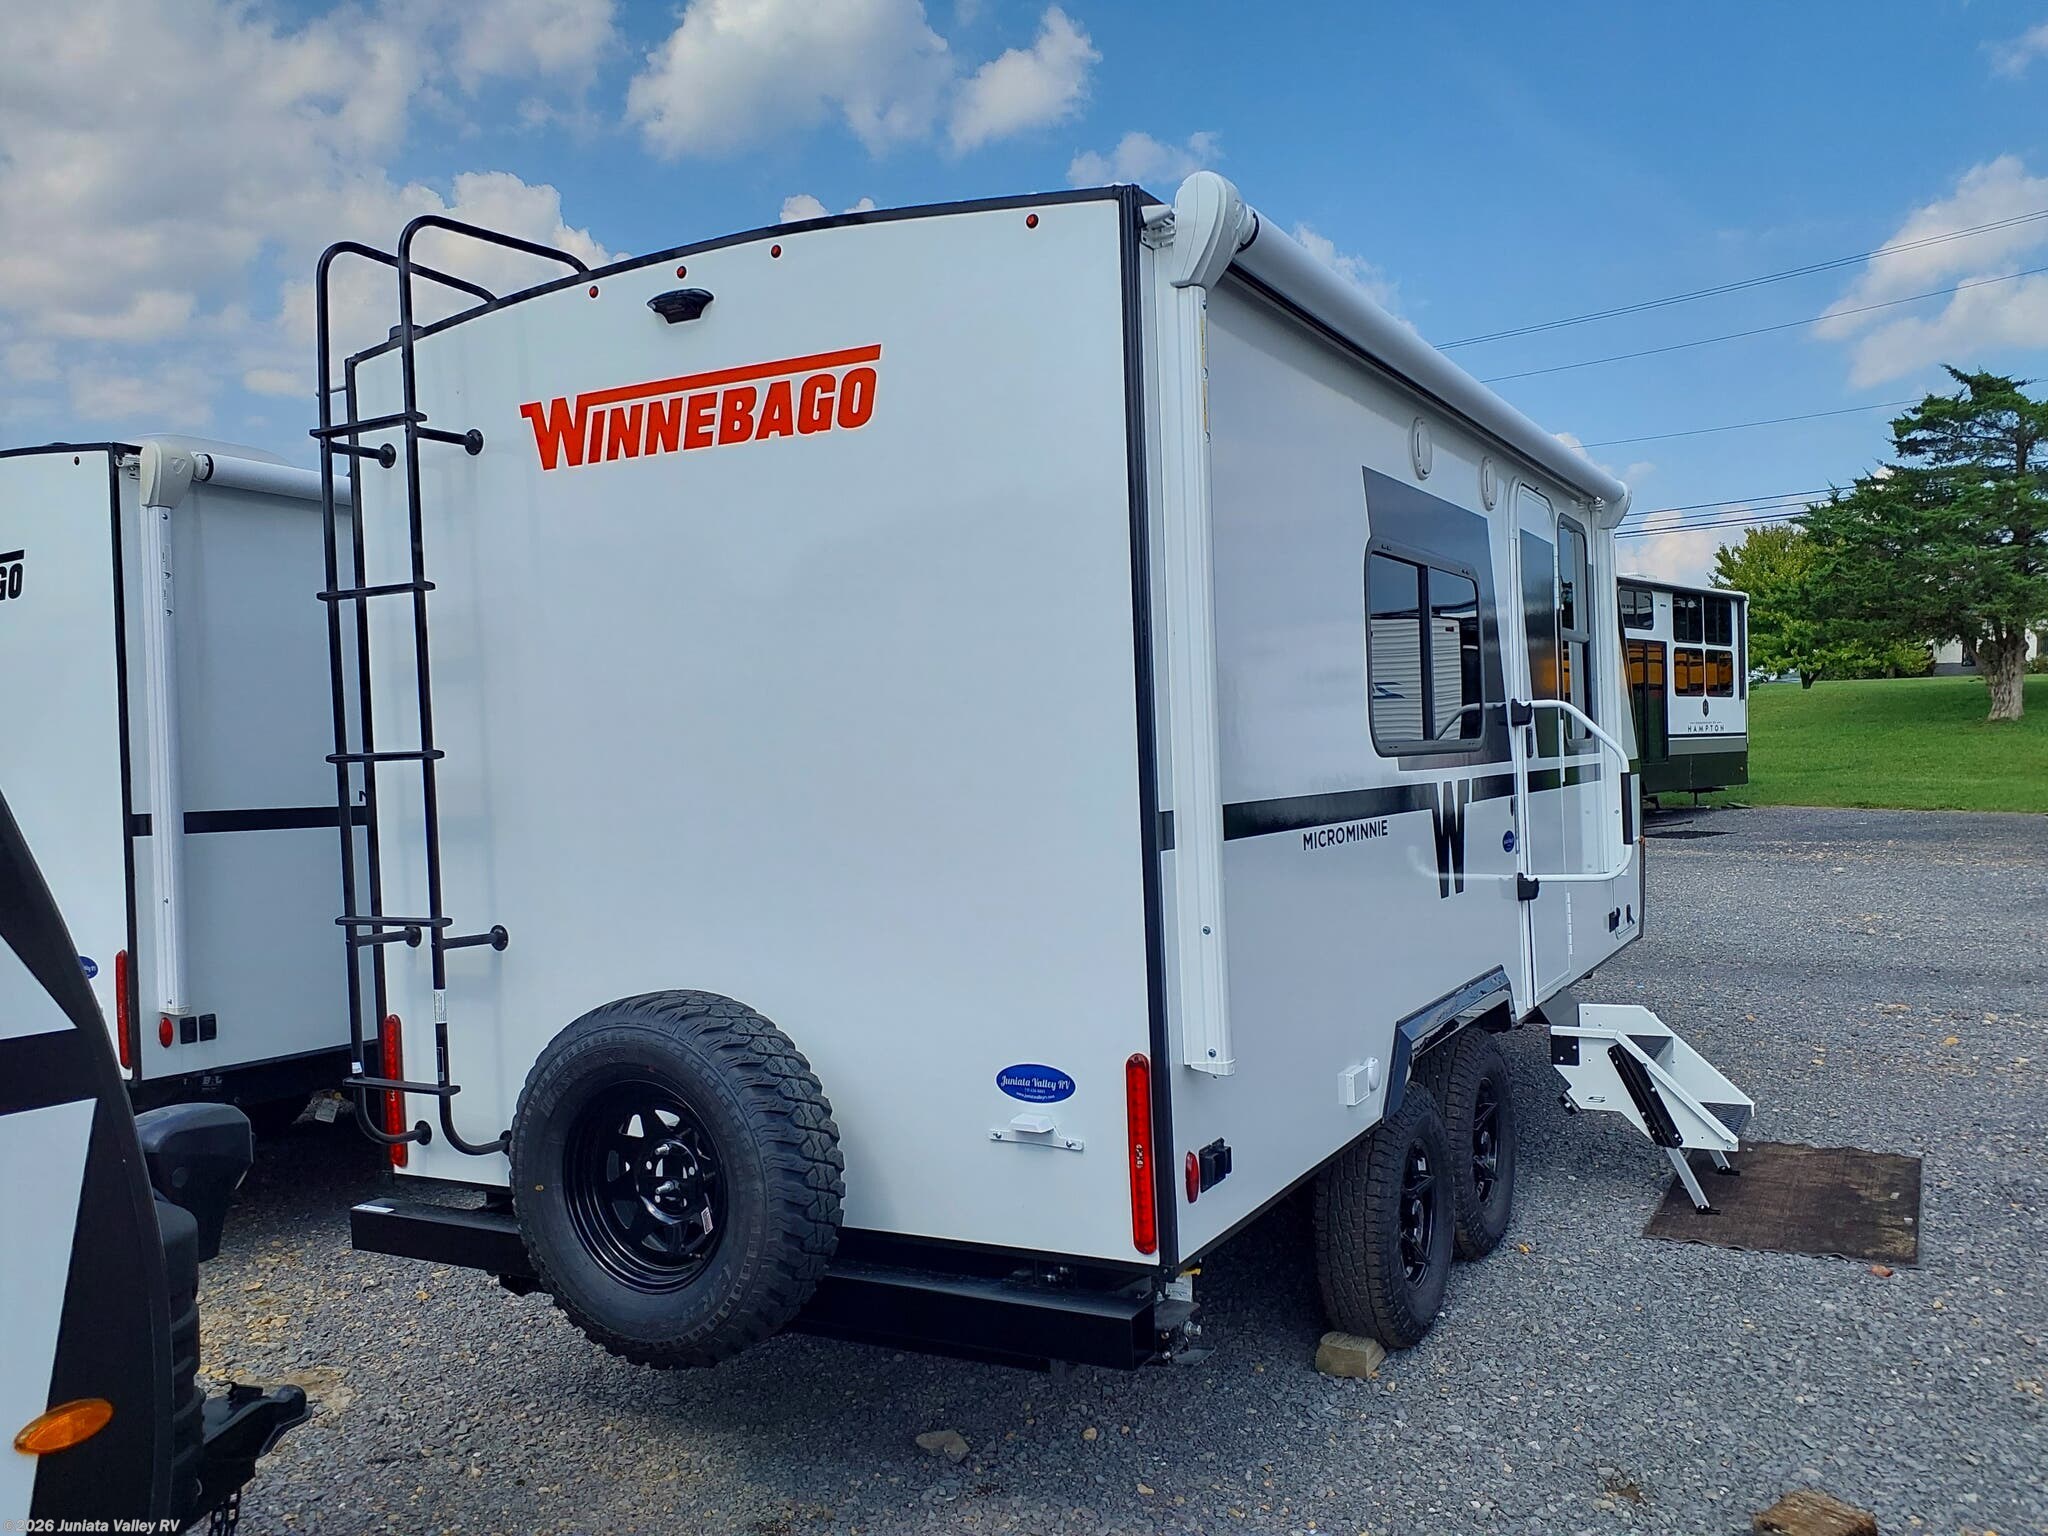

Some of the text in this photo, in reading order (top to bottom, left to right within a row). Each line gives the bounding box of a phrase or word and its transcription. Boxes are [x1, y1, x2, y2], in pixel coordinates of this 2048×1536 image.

[520, 344, 882, 471] WINNEBAGO
[1687, 724, 1725, 733] HAMPTON
[1302, 819, 1389, 851] MICROMINNIE
[1000, 1075, 1031, 1087] Juniata
[1031, 1077, 1056, 1091] Valley
[1057, 1079, 1071, 1090] RV
